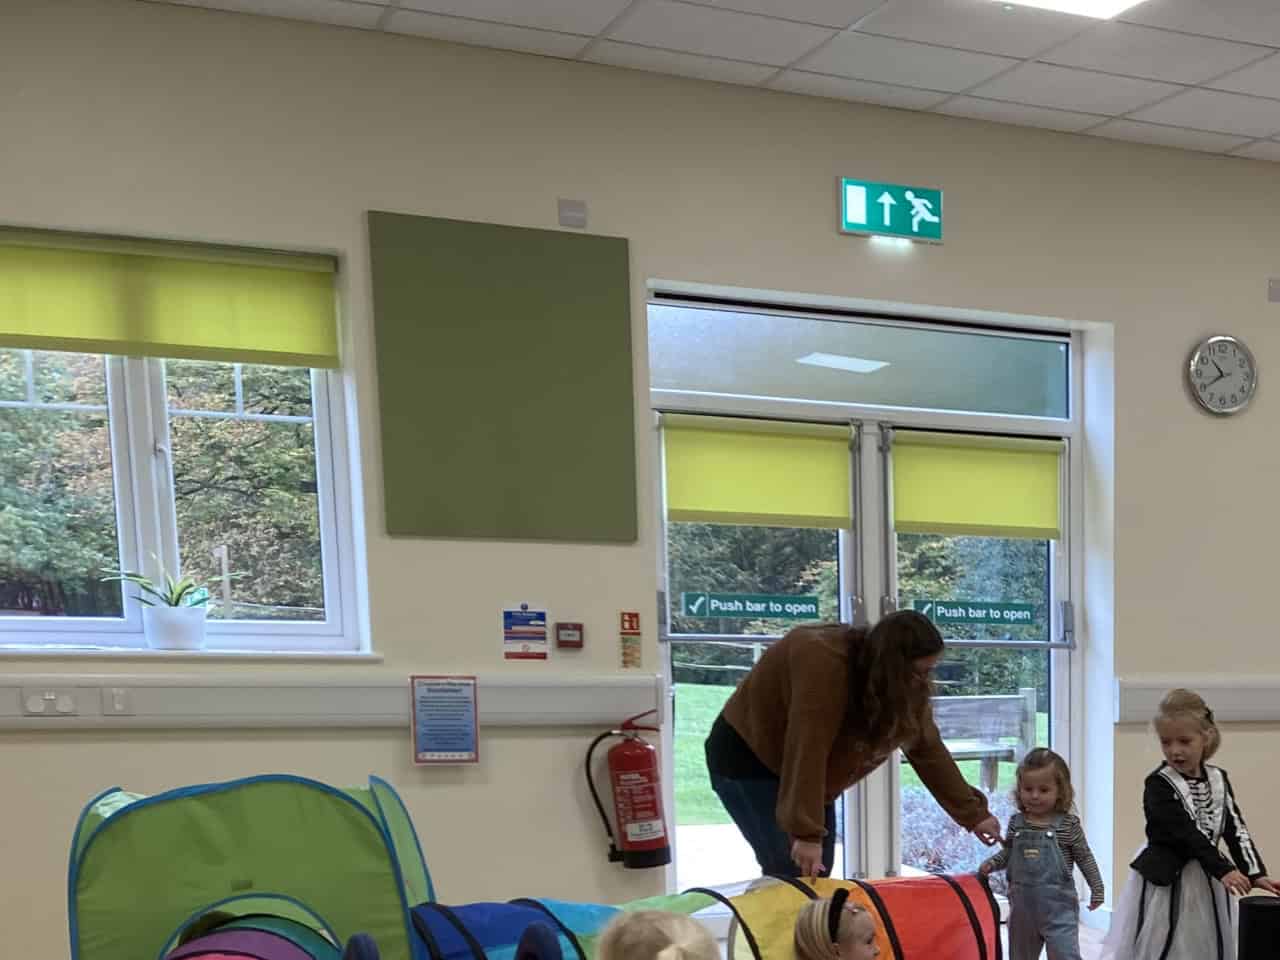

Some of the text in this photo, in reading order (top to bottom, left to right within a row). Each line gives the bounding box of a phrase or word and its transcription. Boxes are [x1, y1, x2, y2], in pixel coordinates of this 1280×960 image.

[710, 599, 817, 616] Push bar to open
[936, 605, 1031, 621] Push bar to open
